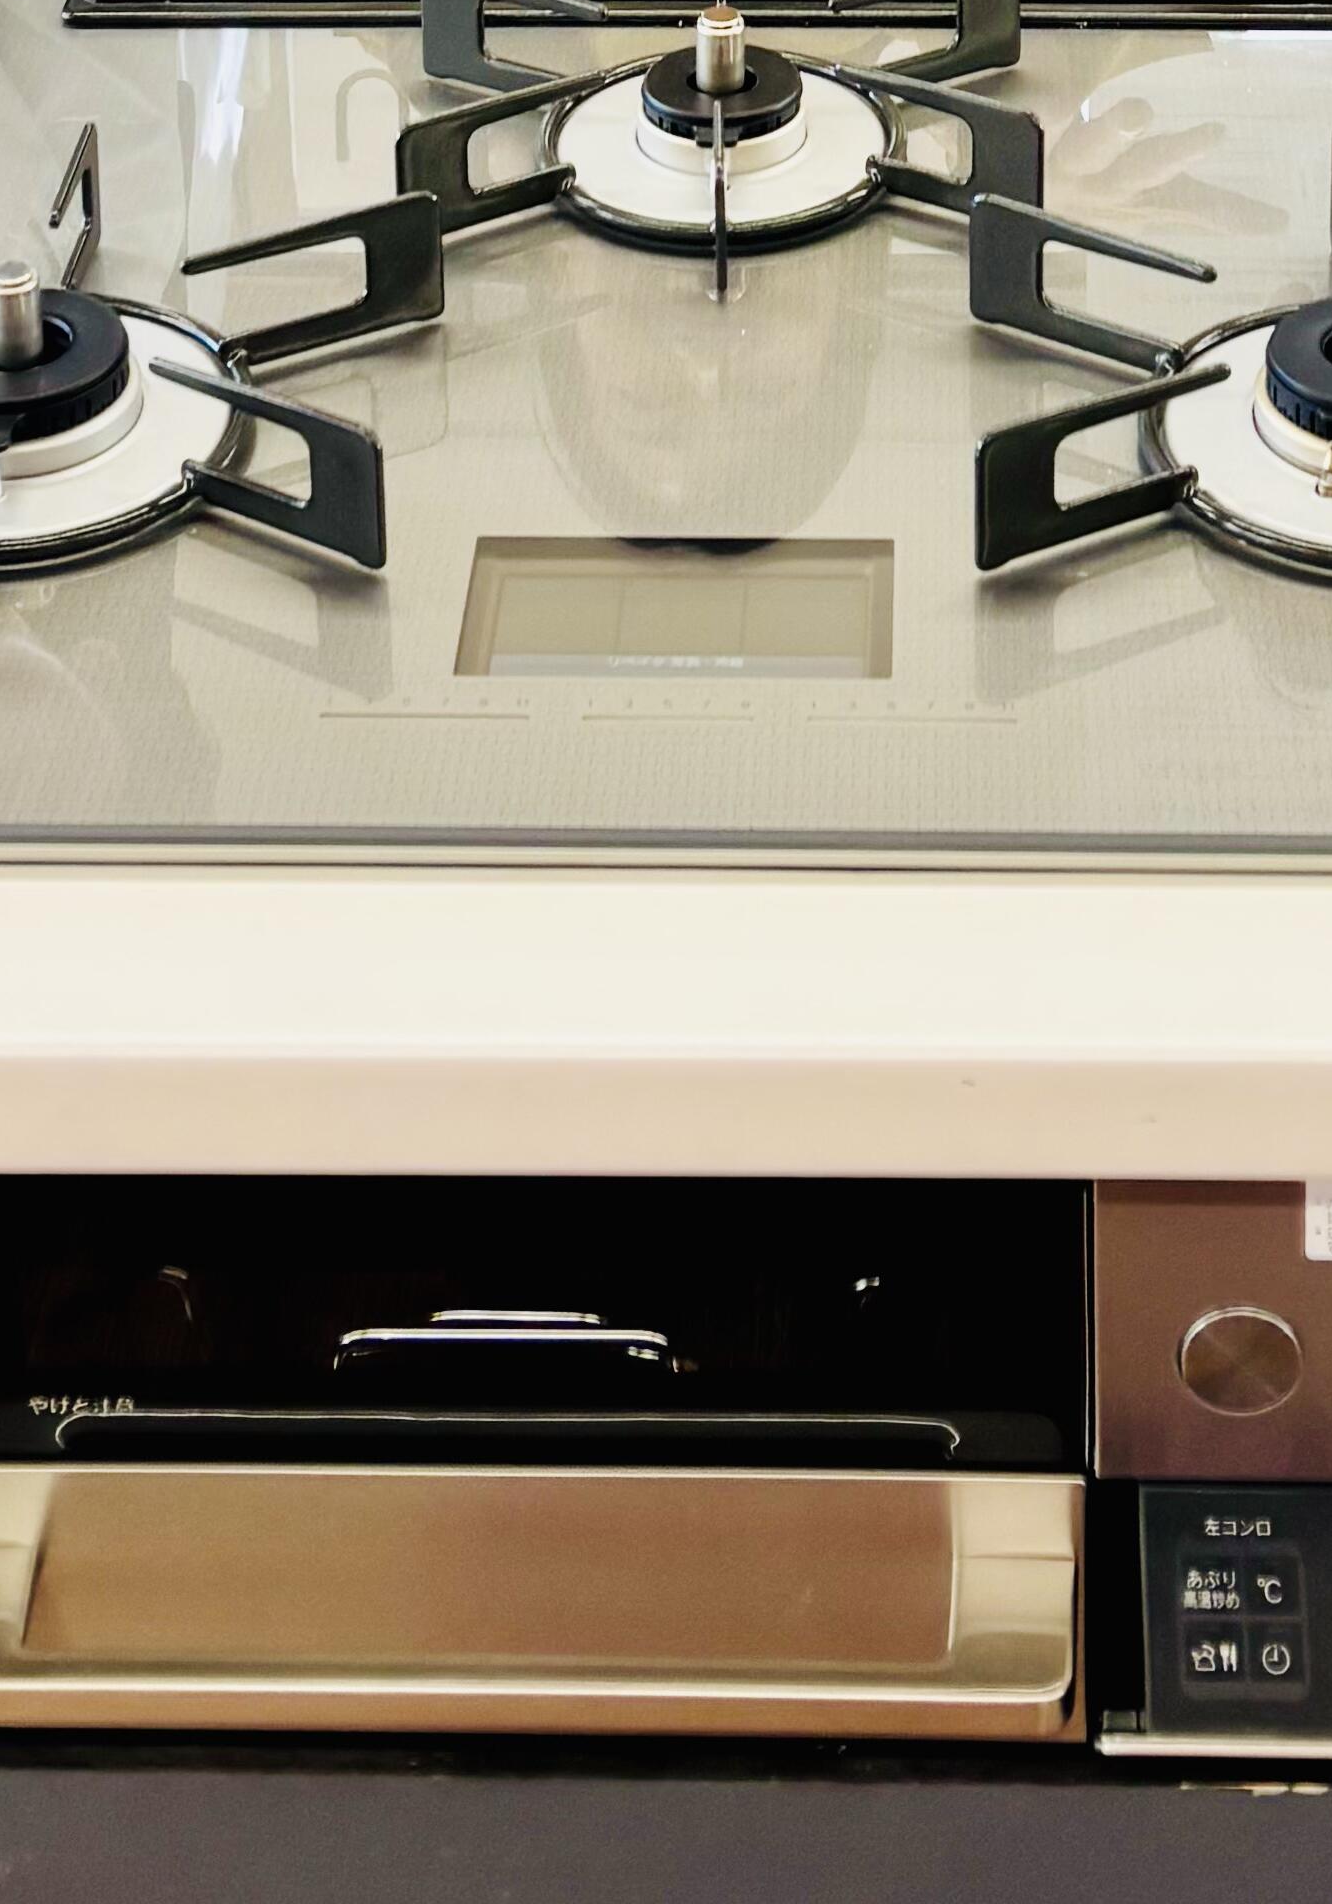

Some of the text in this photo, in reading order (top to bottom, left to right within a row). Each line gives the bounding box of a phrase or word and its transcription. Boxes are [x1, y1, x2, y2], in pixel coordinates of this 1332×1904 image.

[1204, 1516, 1272, 1539] 左コンロ
[1185, 1568, 1238, 1591] あぶり
[1183, 1590, 1241, 1611] 高温炒め
